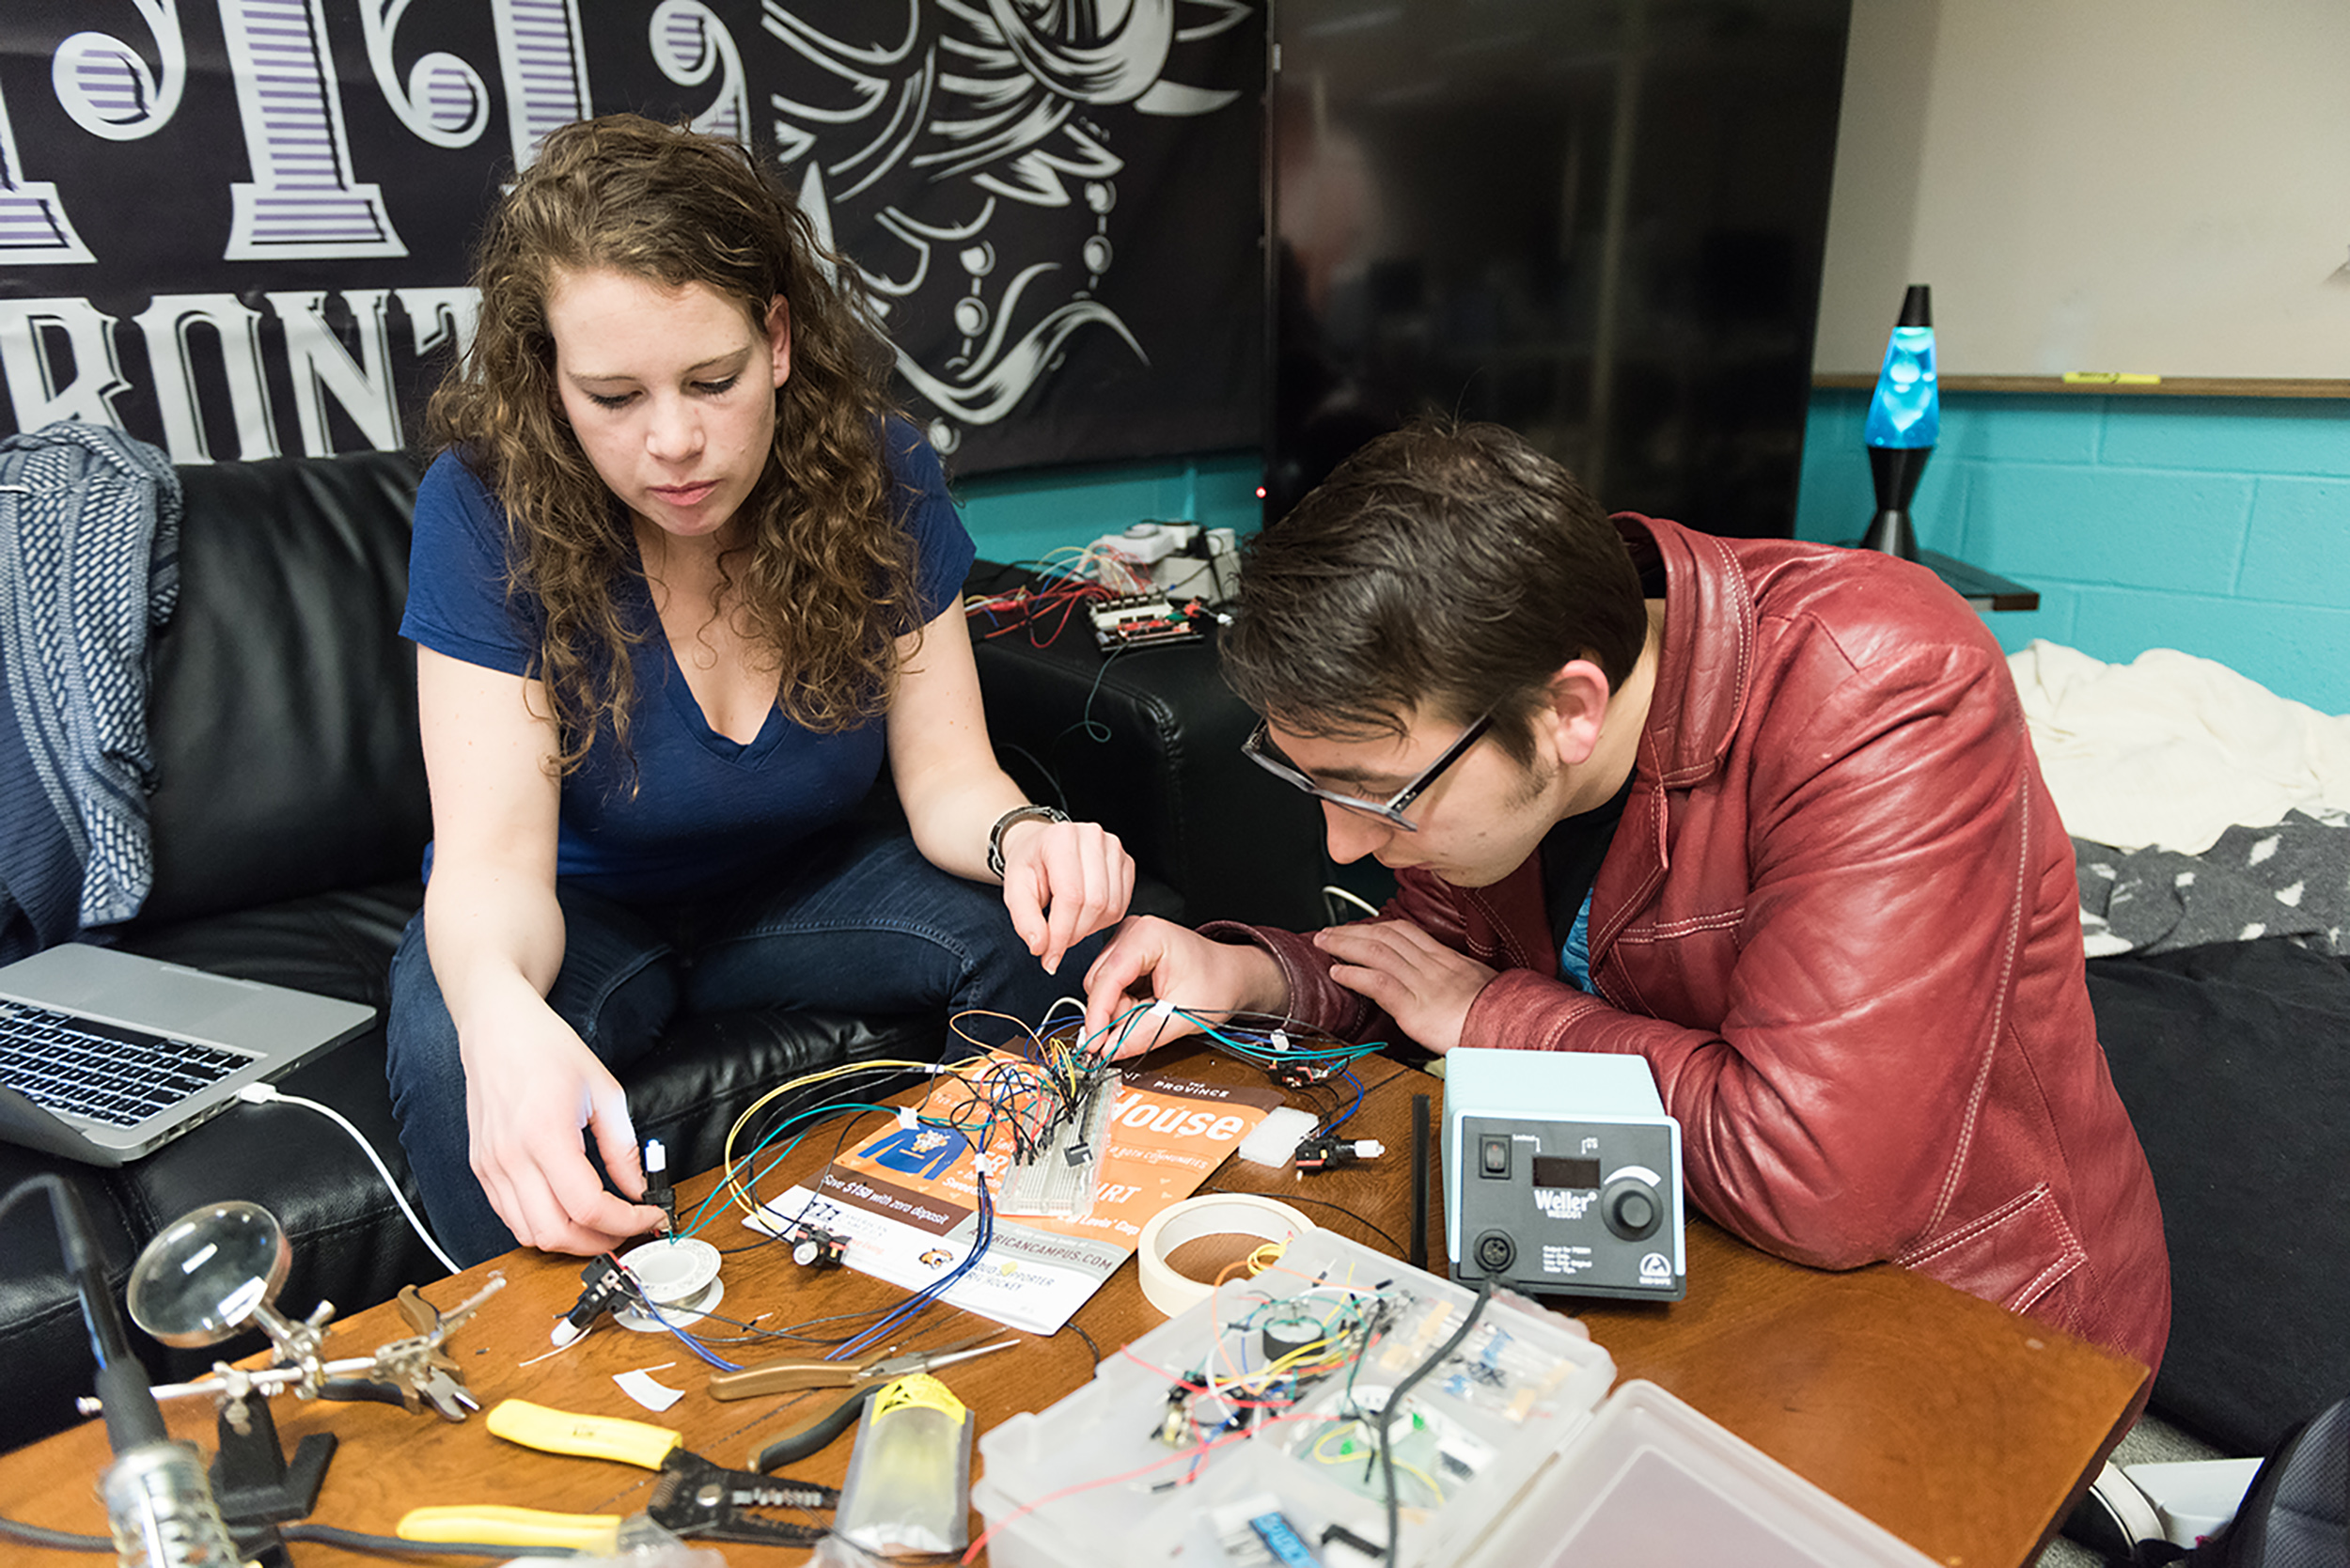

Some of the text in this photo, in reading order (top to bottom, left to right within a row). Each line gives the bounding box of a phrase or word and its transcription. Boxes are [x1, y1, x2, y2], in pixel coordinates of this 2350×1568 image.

[1153, 1080, 1230, 1098] PROVINCE
[1143, 1150, 1209, 1169] COMMUNITIES
[822, 1174, 846, 1189] Save
[867, 1193, 893, 1207] with
[888, 1199, 913, 1213] zero
[910, 1205, 949, 1225] deposit
[1534, 1189, 1589, 1212] Weller
[1115, 1220, 1141, 1236] Cup
[966, 1228, 1114, 1272] AERICANCAMPUS.COM
[999, 1265, 1056, 1288] SPPORTER
